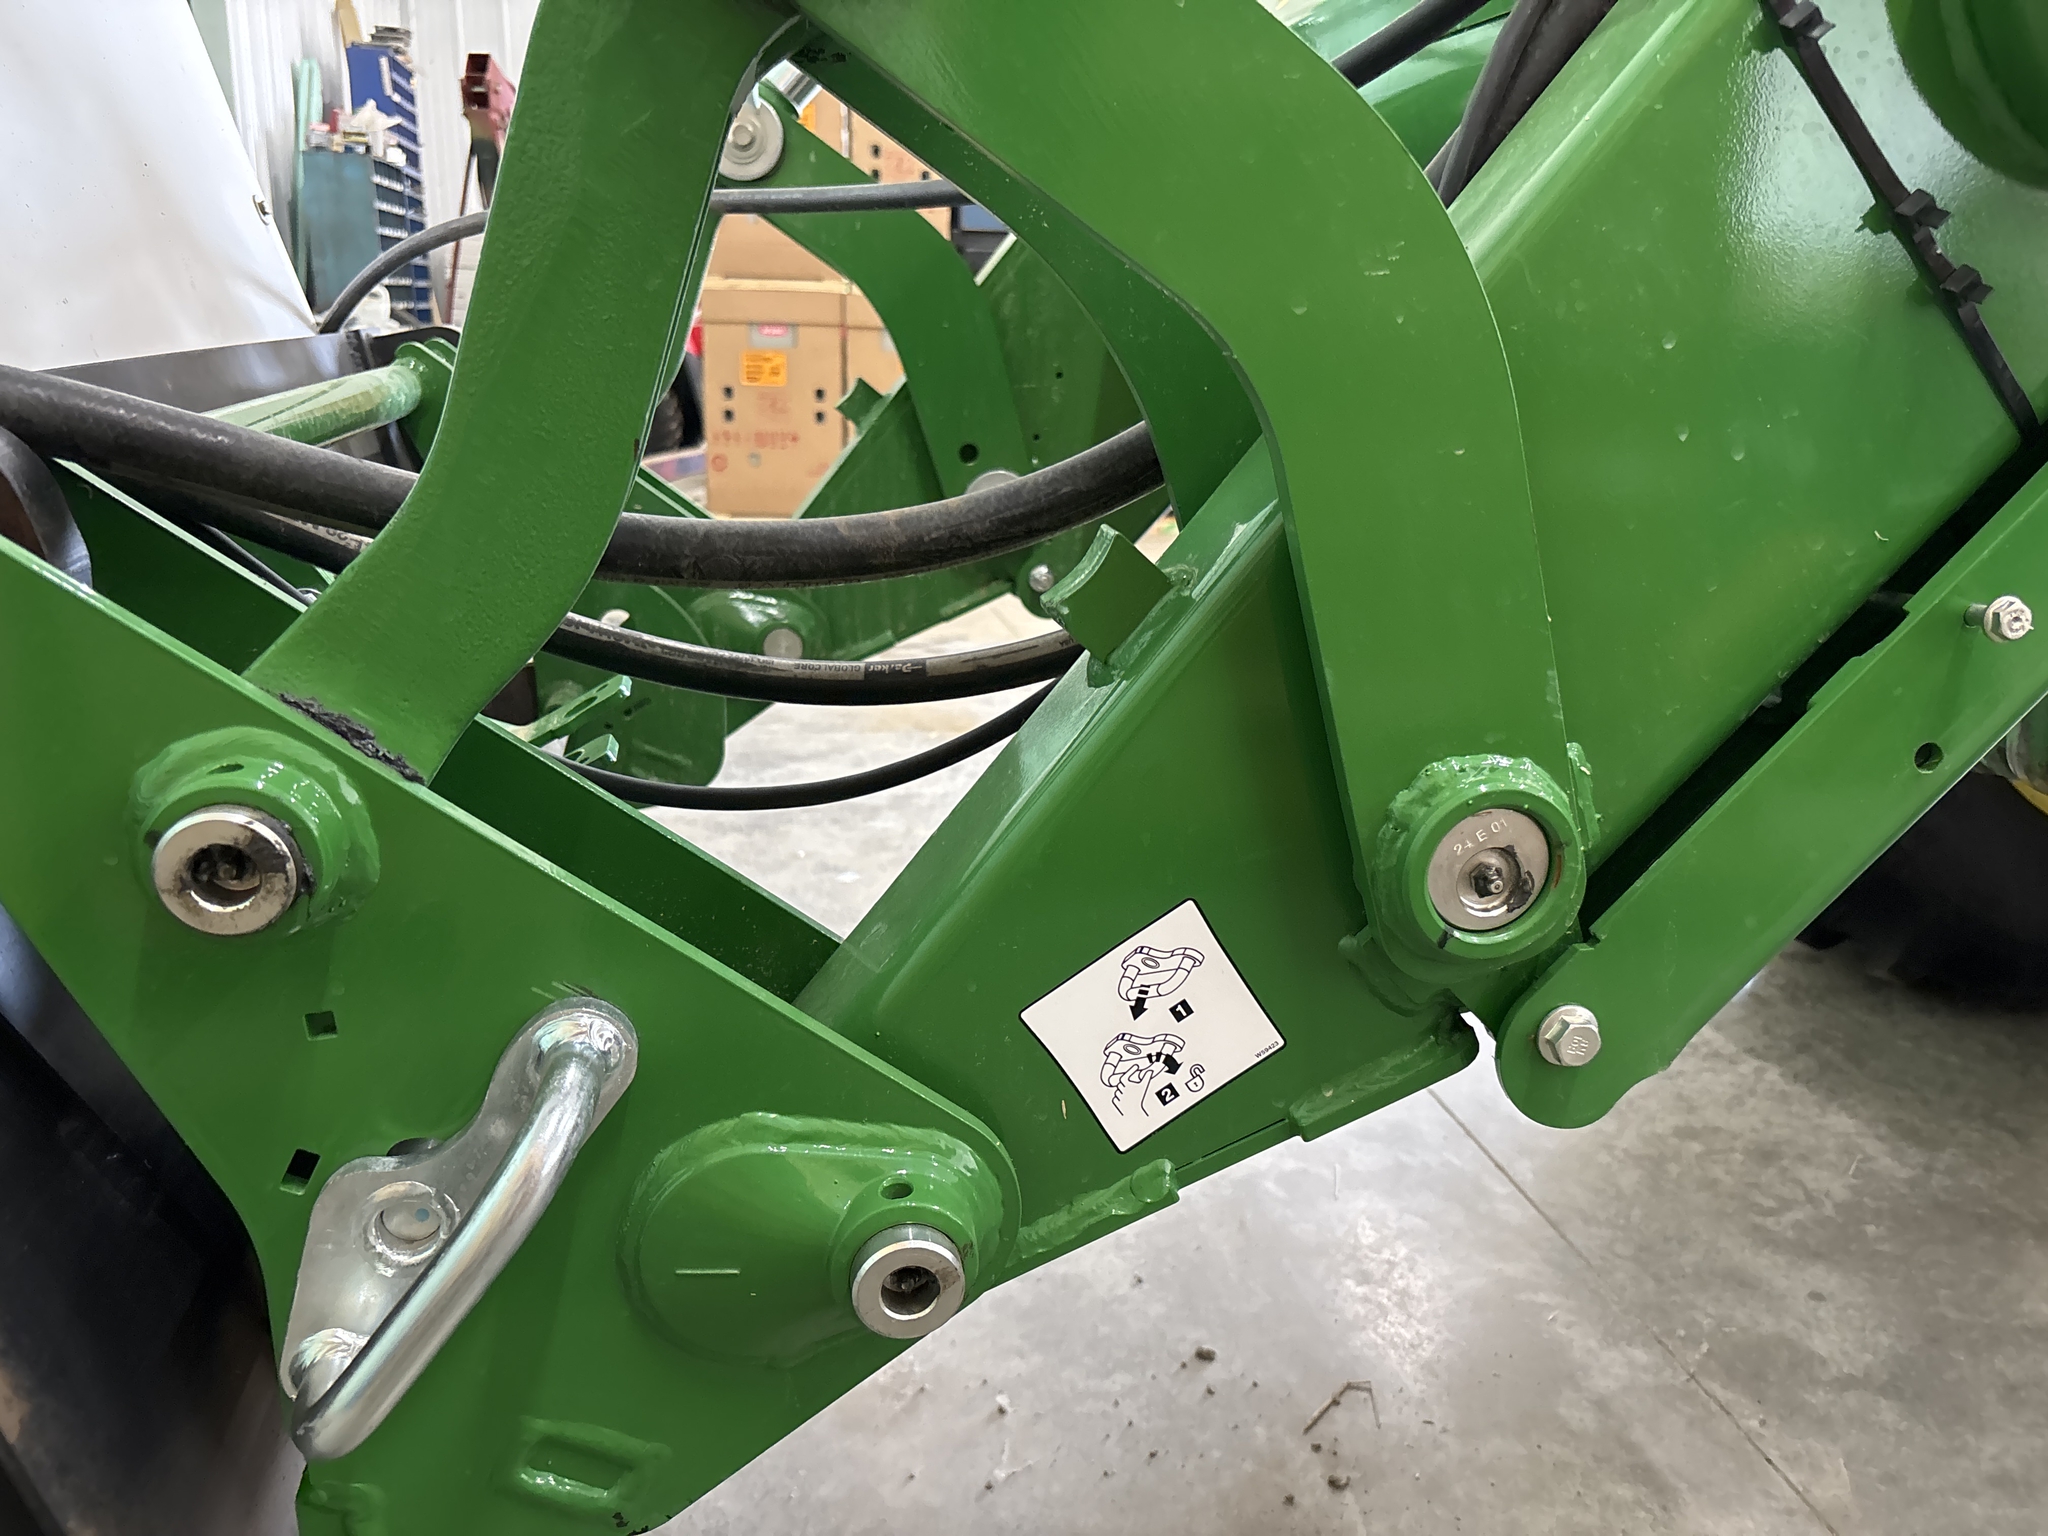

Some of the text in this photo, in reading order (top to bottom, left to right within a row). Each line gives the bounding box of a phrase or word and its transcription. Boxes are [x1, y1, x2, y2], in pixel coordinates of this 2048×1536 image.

[868, 662, 921, 675] Parker
[1453, 817, 1508, 856] 24 E 01
[1161, 1087, 1175, 1102] 2
